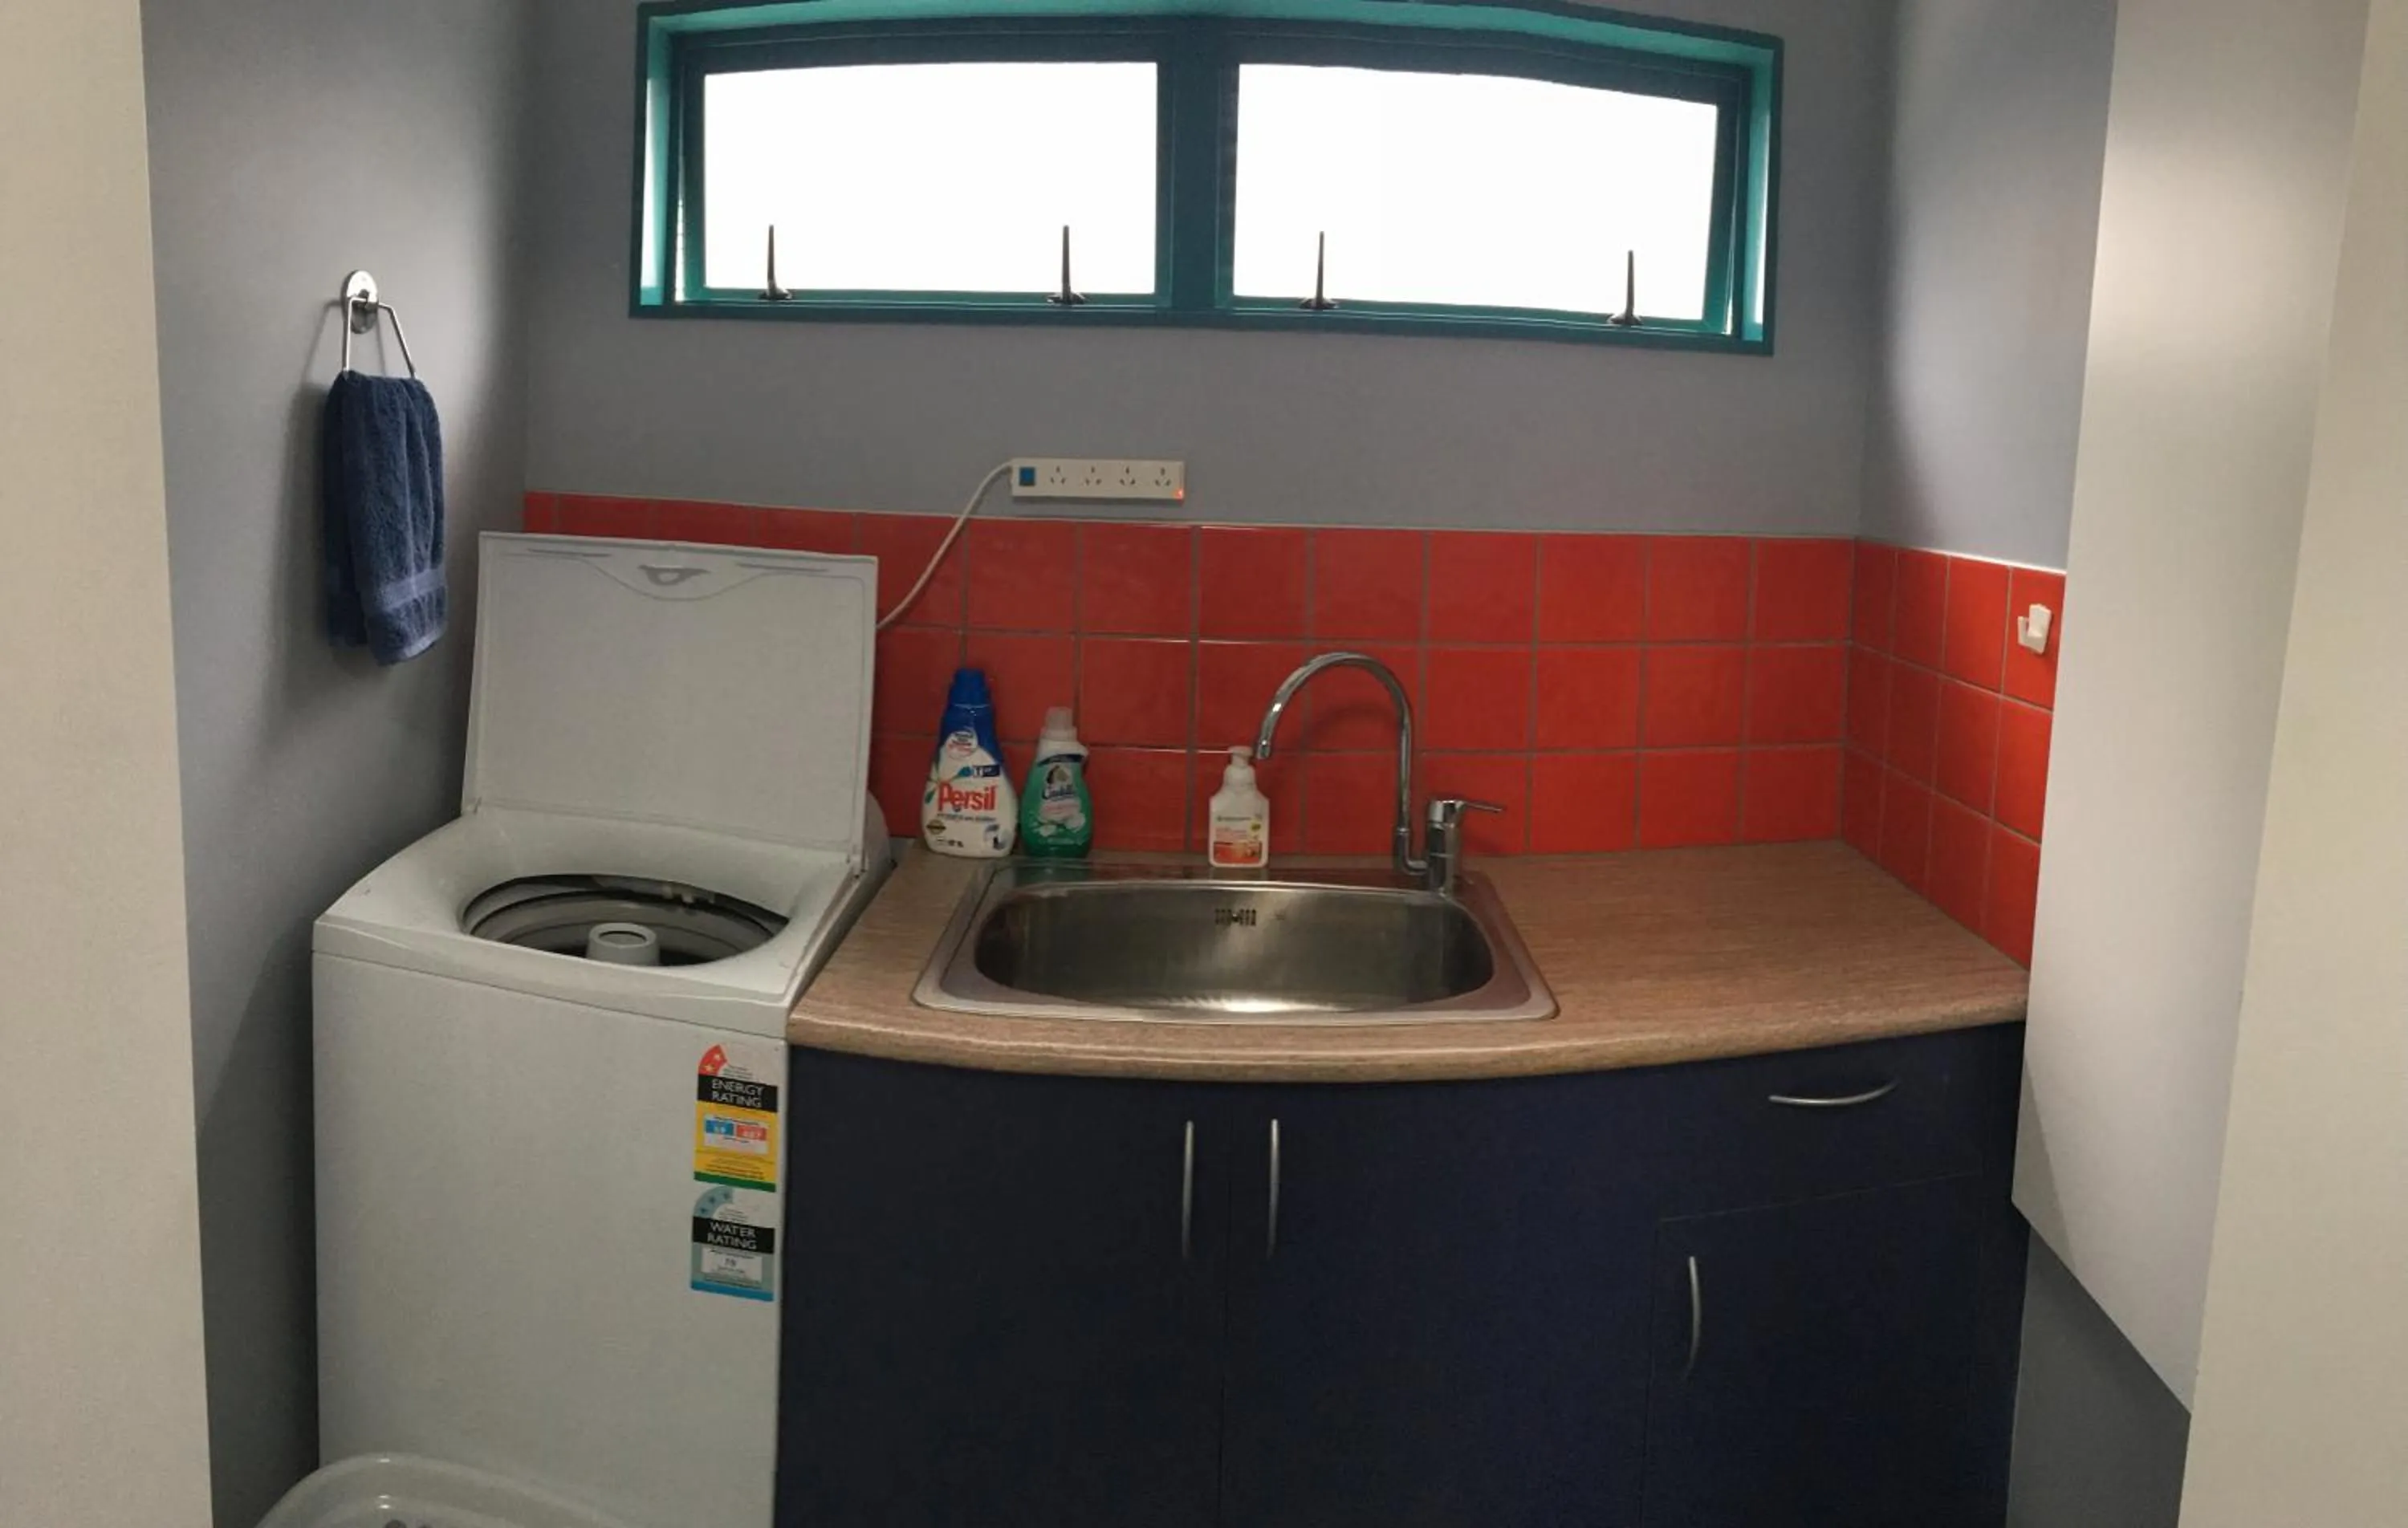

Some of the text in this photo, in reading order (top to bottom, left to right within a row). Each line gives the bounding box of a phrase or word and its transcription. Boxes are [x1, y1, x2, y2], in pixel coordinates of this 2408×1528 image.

[938, 781, 996, 811] Persil
[712, 1078, 763, 1095] ENERGY
[712, 1091, 762, 1107] RATING
[709, 1221, 757, 1237] WATER
[707, 1233, 757, 1250] RATING
